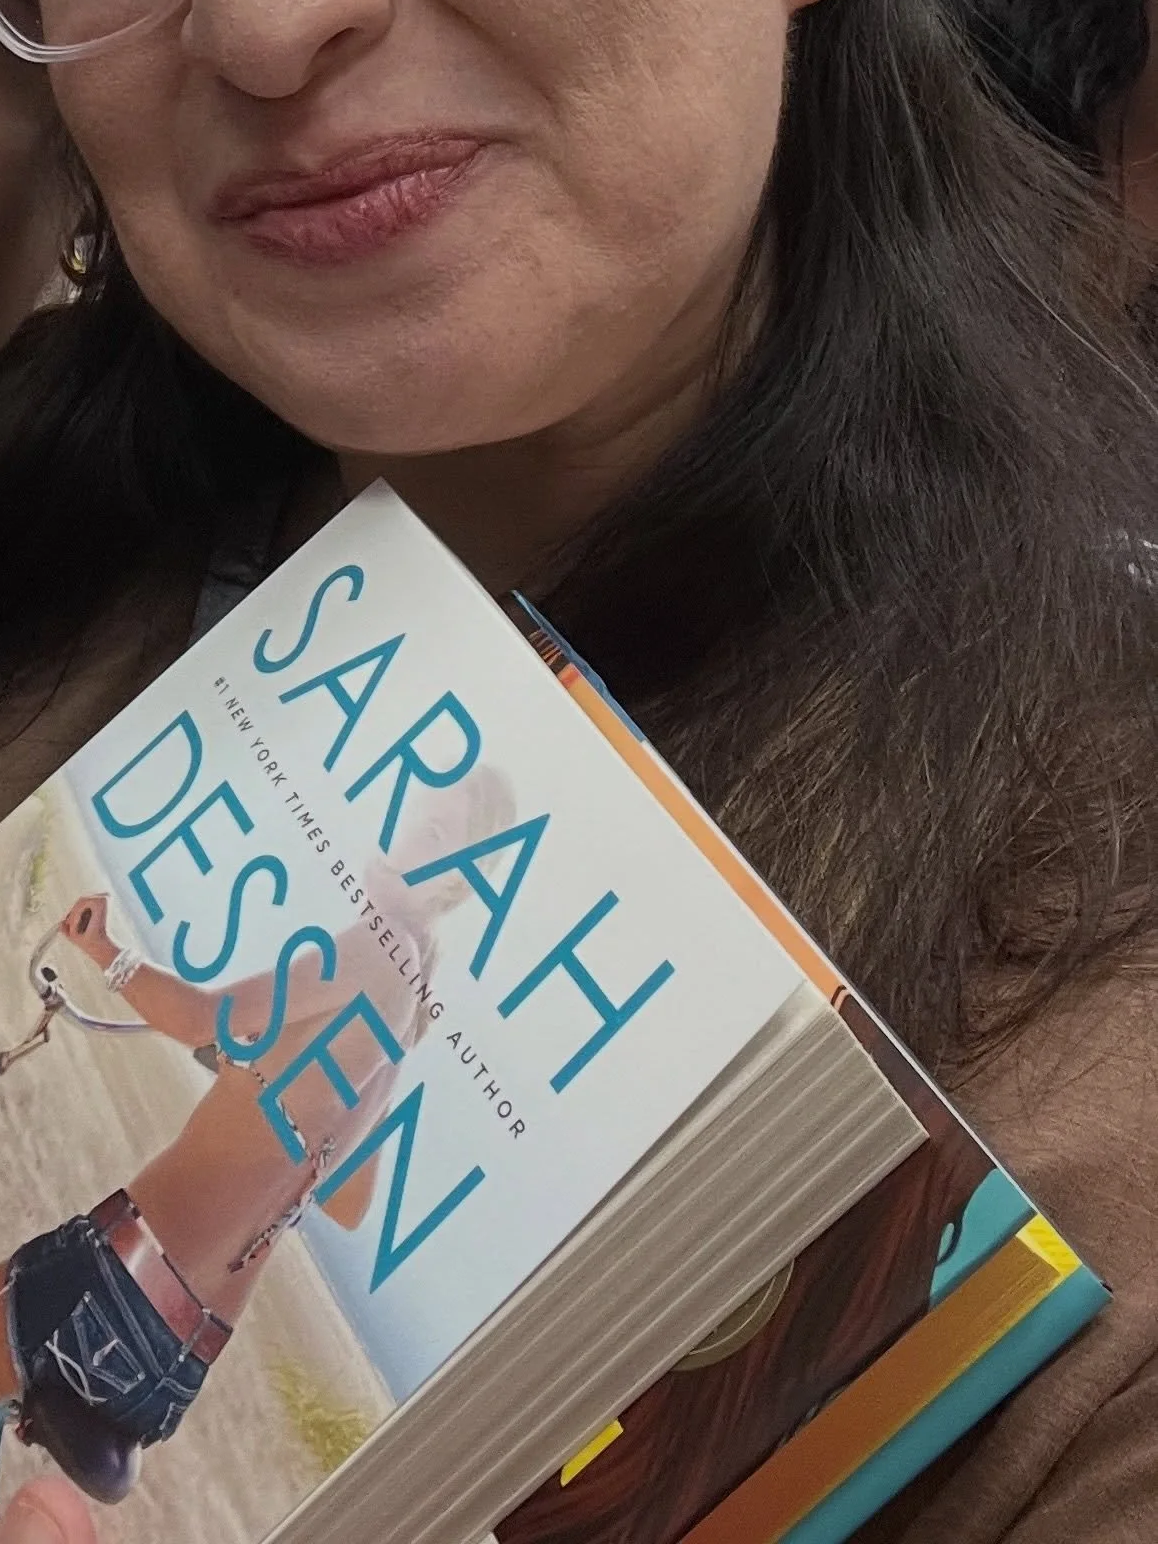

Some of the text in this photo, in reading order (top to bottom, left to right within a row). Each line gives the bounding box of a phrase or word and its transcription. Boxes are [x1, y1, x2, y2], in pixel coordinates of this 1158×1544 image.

[91, 708, 486, 1296] DESSEN
[213, 675, 527, 1140] #1 NEW YORK TIMES BESTSELLING AUTHOR
[252, 563, 676, 1095] SARAH
